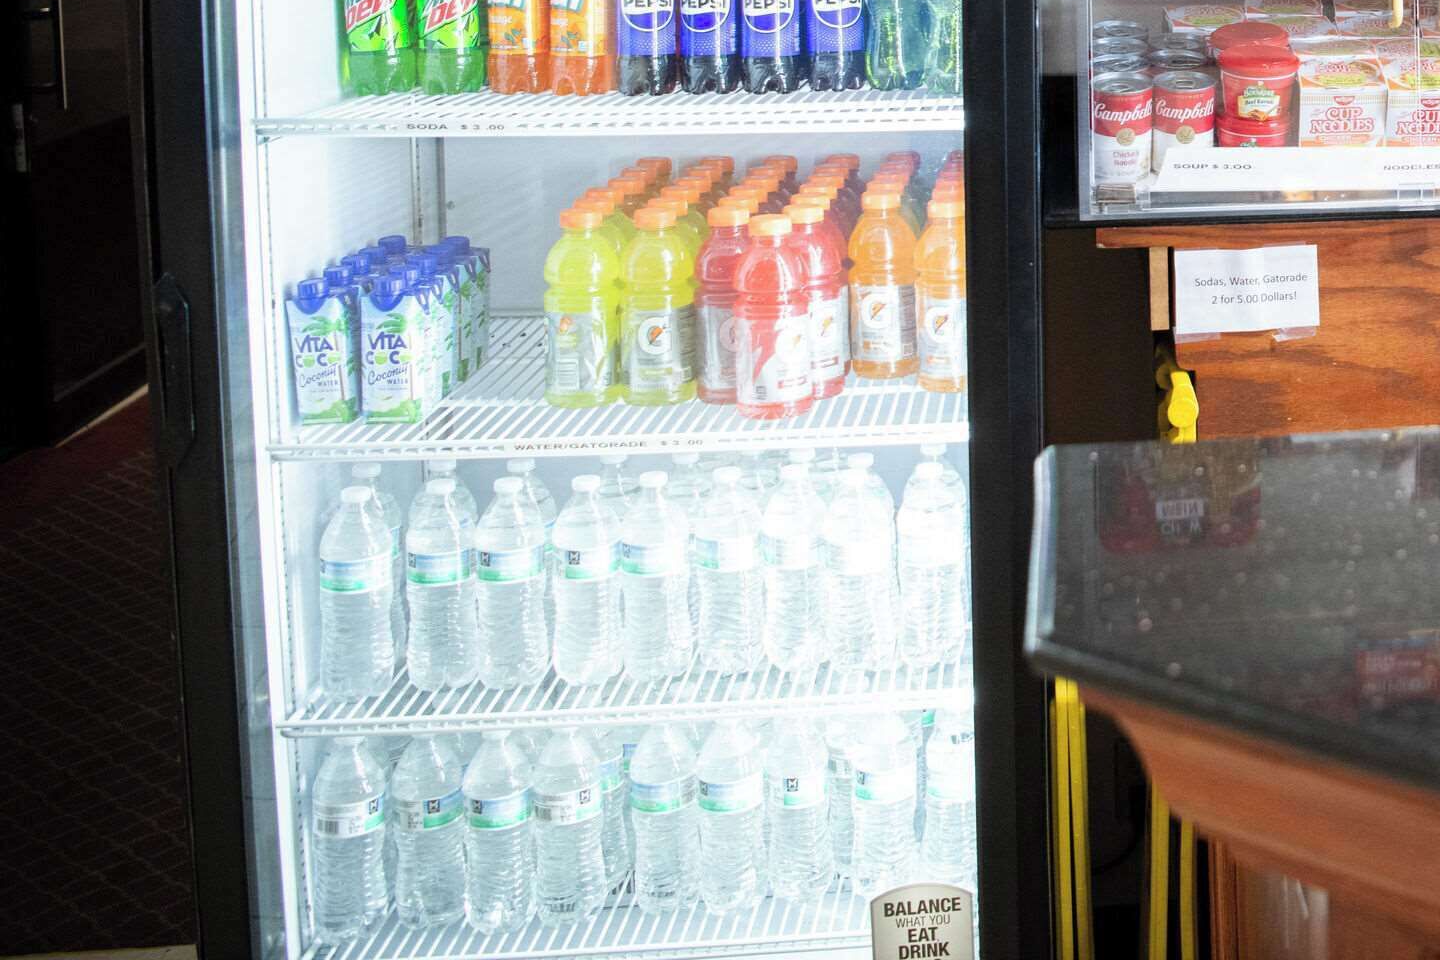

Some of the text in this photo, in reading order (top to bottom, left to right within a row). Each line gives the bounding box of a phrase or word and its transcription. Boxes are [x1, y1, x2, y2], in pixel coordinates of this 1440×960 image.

[1325, 106, 1363, 120] CUP
[1310, 118, 1375, 134] NOODLES
[1194, 272, 1308, 287] Sodas, Water, Gatorade
[1211, 290, 1297, 304] 2 for 5.00 Dollars!
[295, 334, 334, 353] VITA
[367, 331, 408, 350] VITA
[514, 441, 649, 450] WATER/GATORADE
[884, 897, 962, 917] BALANCE
[895, 914, 951, 928] WHAT YOU
[907, 926, 939, 943] EAT
[898, 941, 951, 960] DRINK
